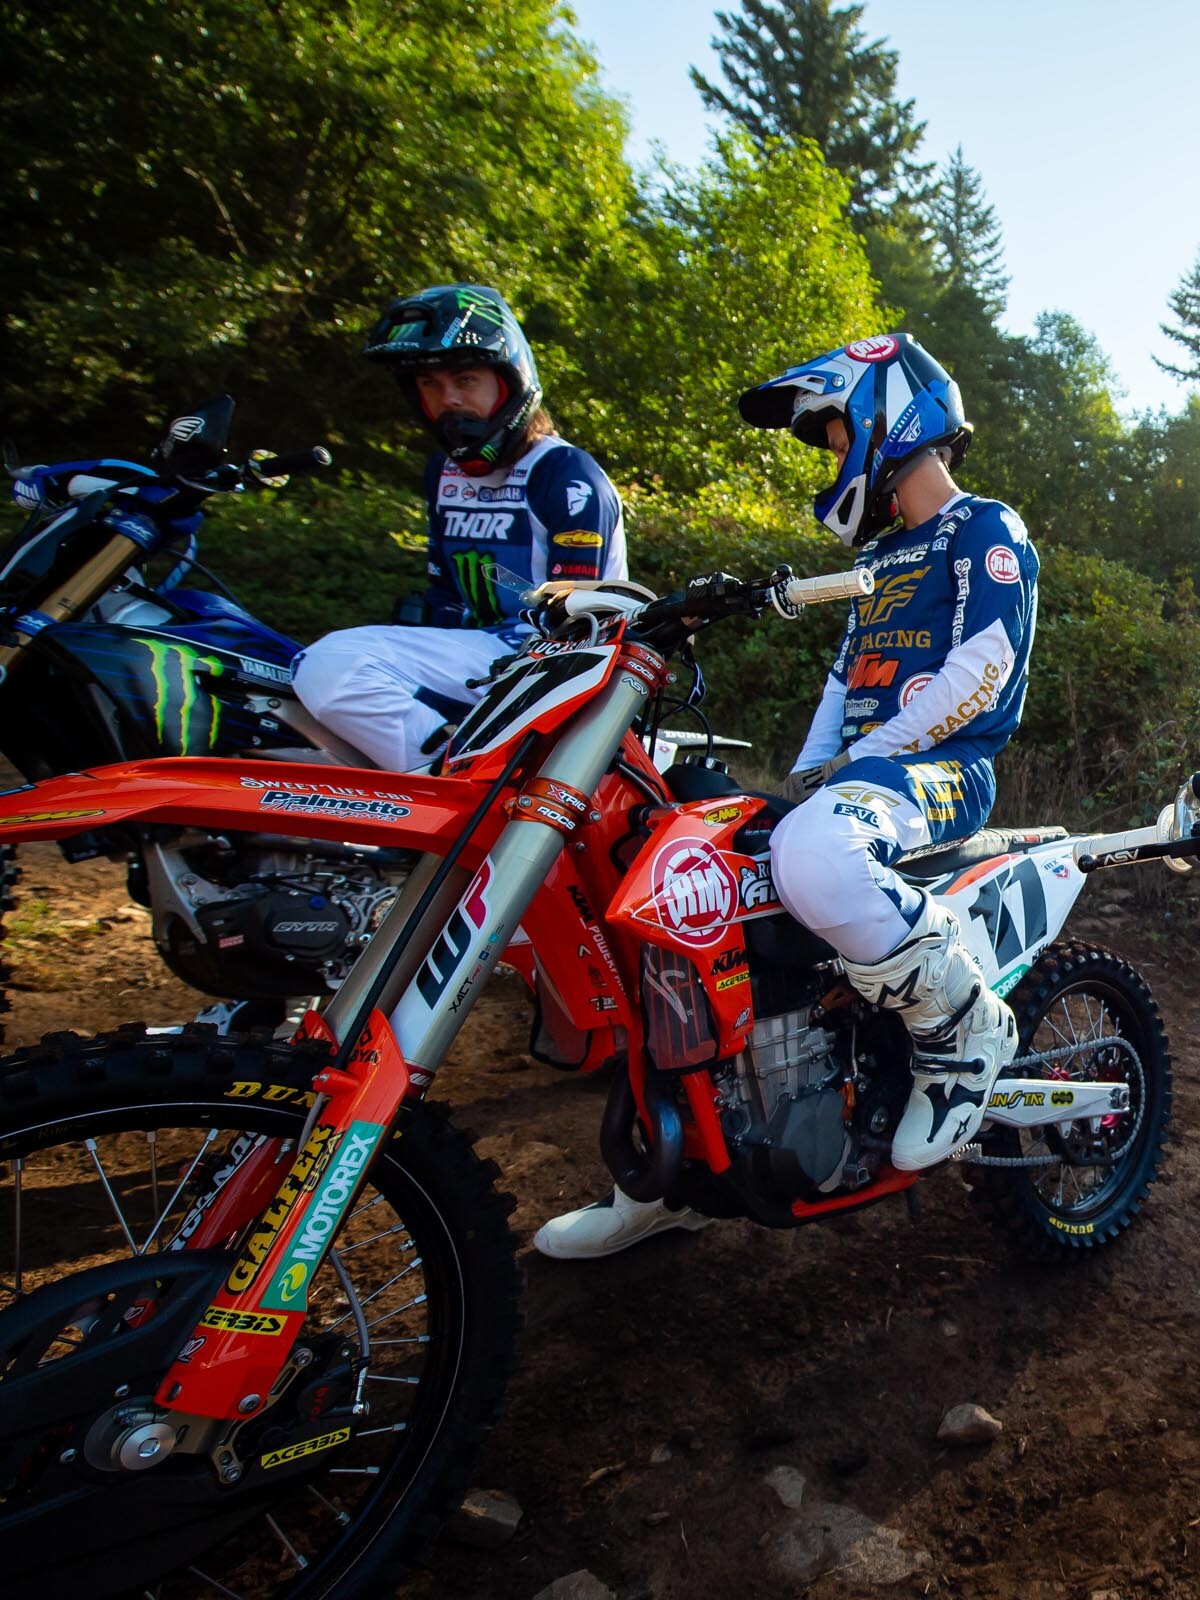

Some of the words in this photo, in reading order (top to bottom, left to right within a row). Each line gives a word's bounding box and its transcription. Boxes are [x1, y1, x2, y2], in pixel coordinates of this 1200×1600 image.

[444, 511, 515, 540] THOR
[689, 576, 713, 588] ASV
[859, 629, 931, 651] RACING
[622, 676, 649, 697] ASV
[926, 663, 999, 743] RACING
[260, 790, 411, 818] Palmetto
[373, 791, 415, 803] CBD
[549, 784, 587, 812] XTRIG
[537, 801, 576, 830] ROCS
[1103, 848, 1139, 866] ASV
[710, 947, 750, 977] KTM
[225, 1124, 334, 1294] GALFER
[292, 1133, 378, 1261] MOTOREX
[201, 1308, 281, 1333] CERBIS
[262, 1427, 349, 1468] ACERBIS
